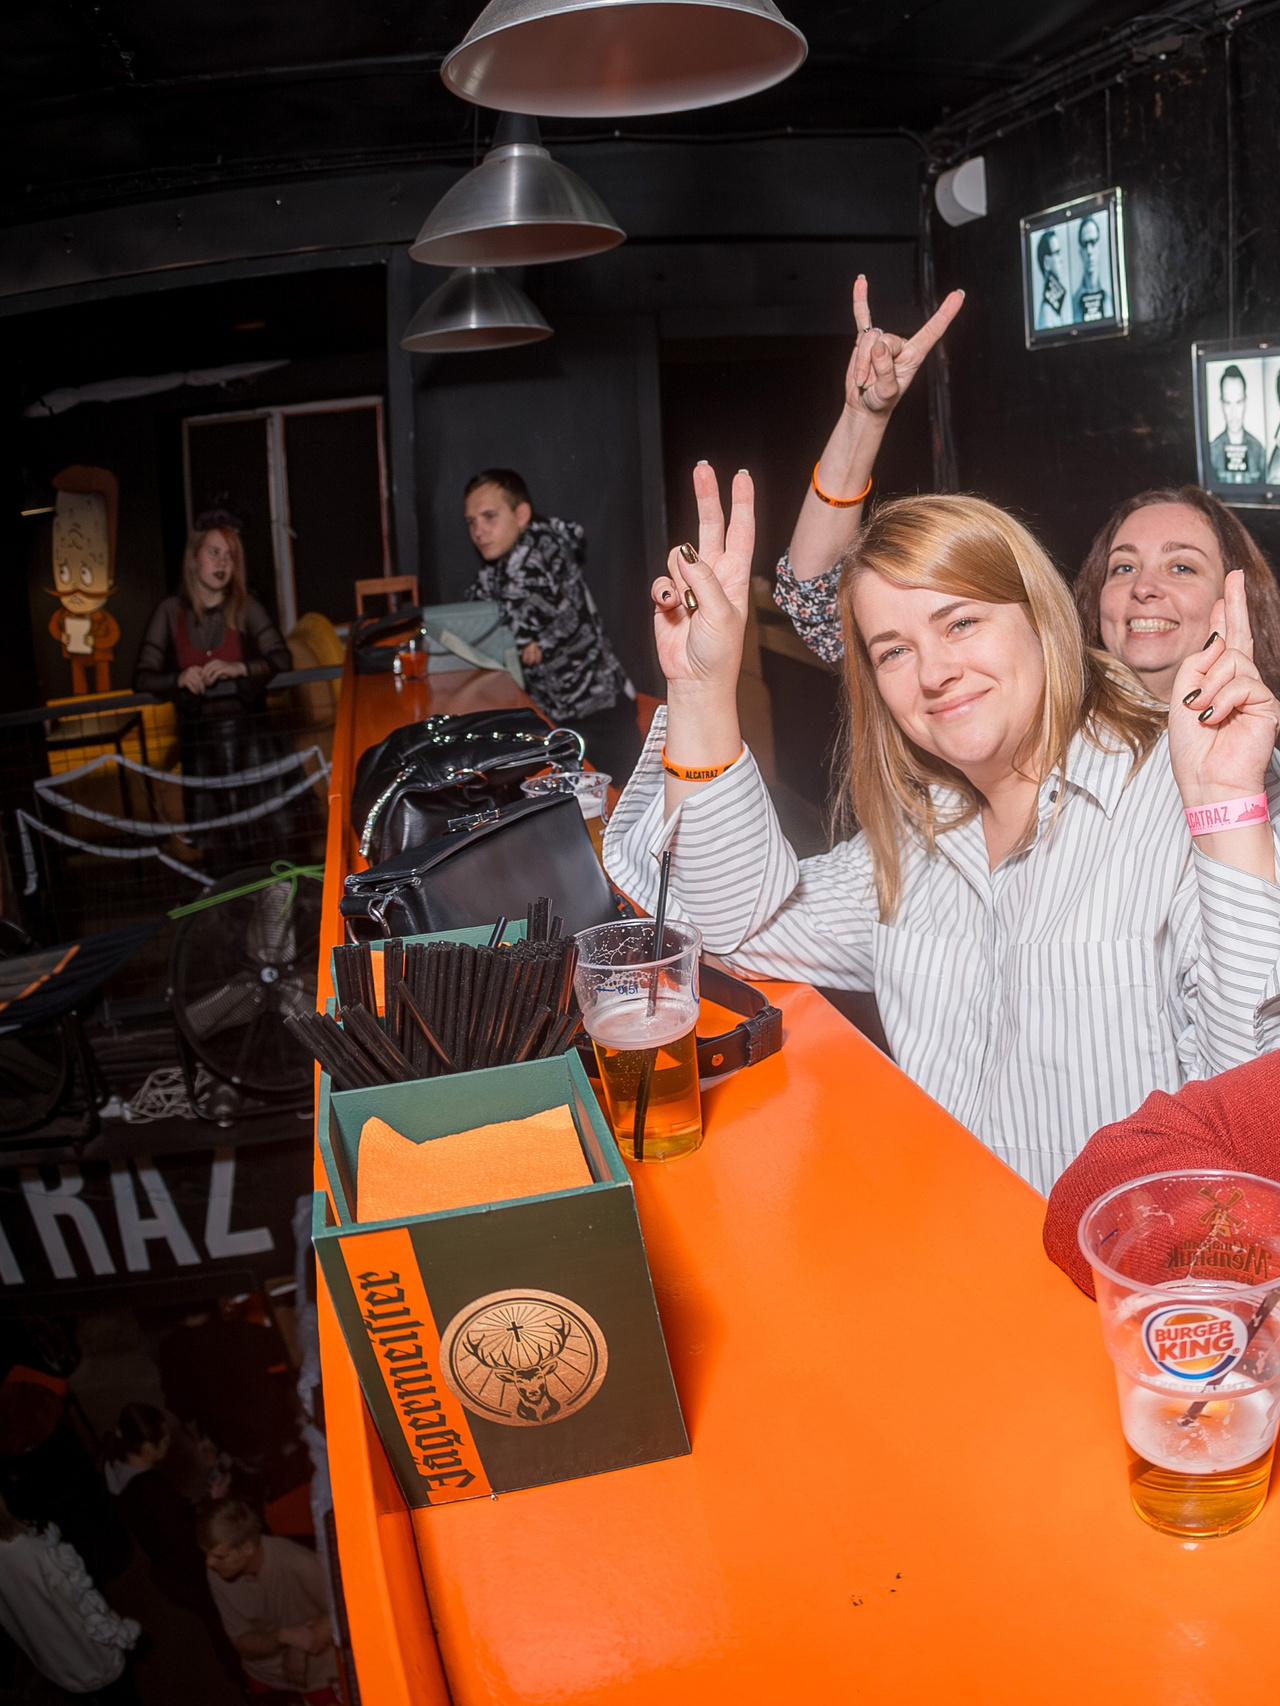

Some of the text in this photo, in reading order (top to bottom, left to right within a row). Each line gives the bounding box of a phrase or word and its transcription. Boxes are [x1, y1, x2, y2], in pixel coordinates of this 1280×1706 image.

[685, 769, 718, 779] ALCATRAZ
[1155, 1320, 1232, 1343] BURGER
[1158, 1333, 1235, 1361] KING
